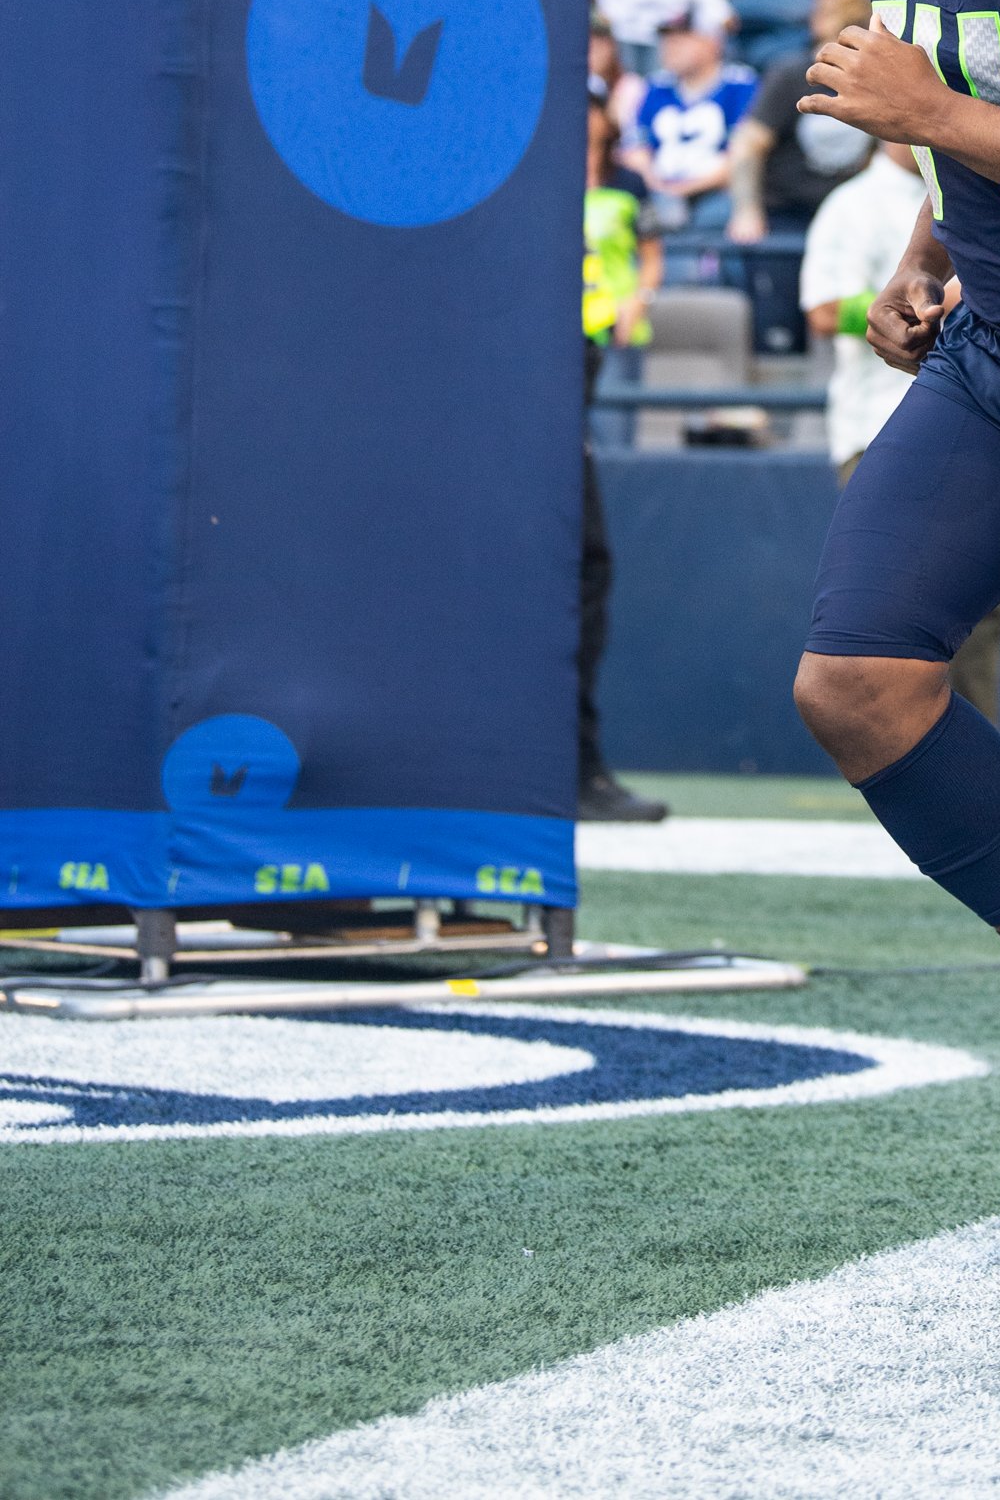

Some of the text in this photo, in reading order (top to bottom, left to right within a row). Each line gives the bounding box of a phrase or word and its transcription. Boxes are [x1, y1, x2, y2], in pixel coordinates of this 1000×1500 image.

[60, 863, 109, 890] SEA
[256, 864, 545, 895] SEA SEA
